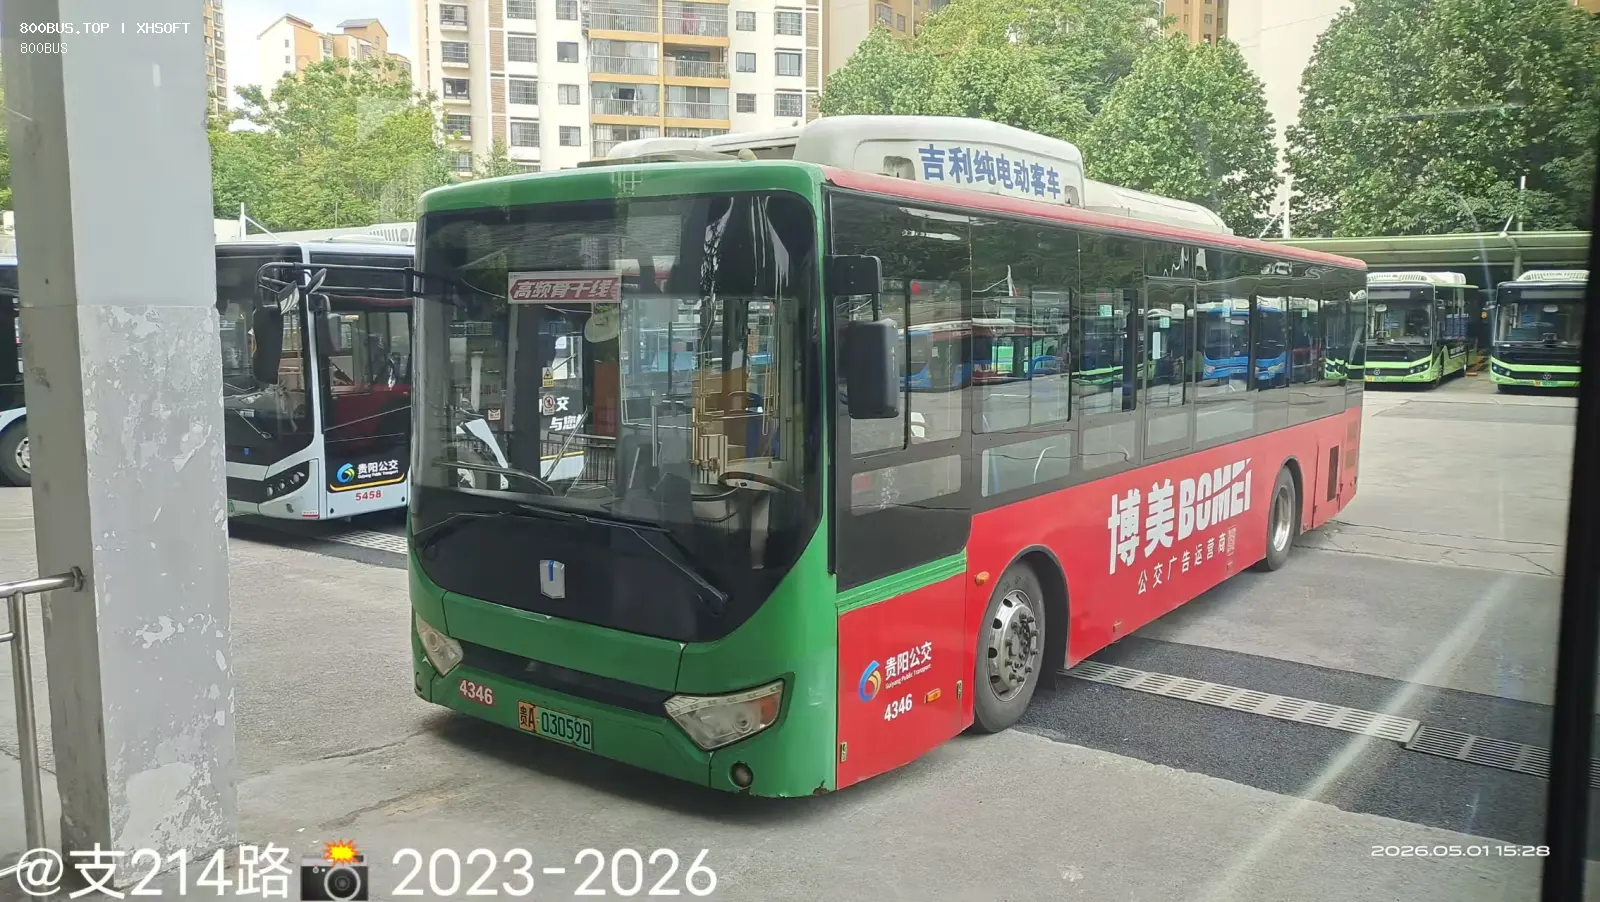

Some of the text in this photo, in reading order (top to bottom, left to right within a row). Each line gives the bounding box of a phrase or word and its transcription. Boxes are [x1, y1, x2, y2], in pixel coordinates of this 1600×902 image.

[918, 143, 1061, 199] 吉利纯电动客车
[514, 279, 613, 299] 高频骨干线
[357, 460, 398, 475] 贵阳公交
[355, 490, 382, 501] 5458
[1137, 532, 1227, 595] 公交广告运营商
[885, 641, 932, 680] 贵阳公交
[459, 679, 494, 705] 4346
[884, 694, 912, 721] 4346
